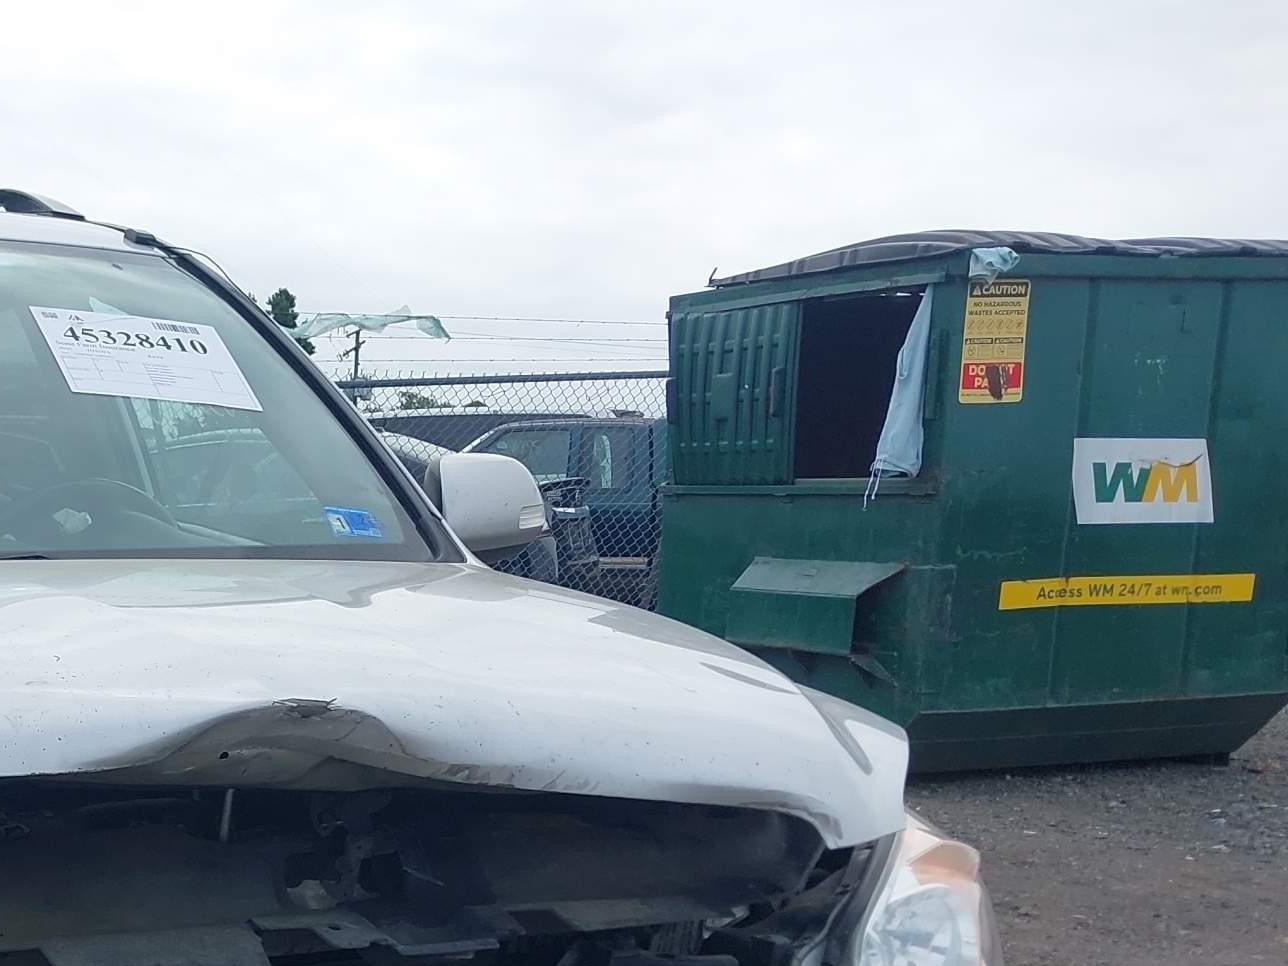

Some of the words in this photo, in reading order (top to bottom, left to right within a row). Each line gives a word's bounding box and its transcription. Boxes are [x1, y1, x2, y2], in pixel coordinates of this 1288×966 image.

[982, 285, 1026, 295] CAUTION
[63, 326, 208, 355] 45328410
[968, 364, 986, 376] DO
[1093, 461, 1199, 503] WM
[1036, 586, 1082, 600] Access
[1088, 584, 1114, 597] WM
[1118, 583, 1152, 597] 24/7
[1156, 585, 1168, 596] at
